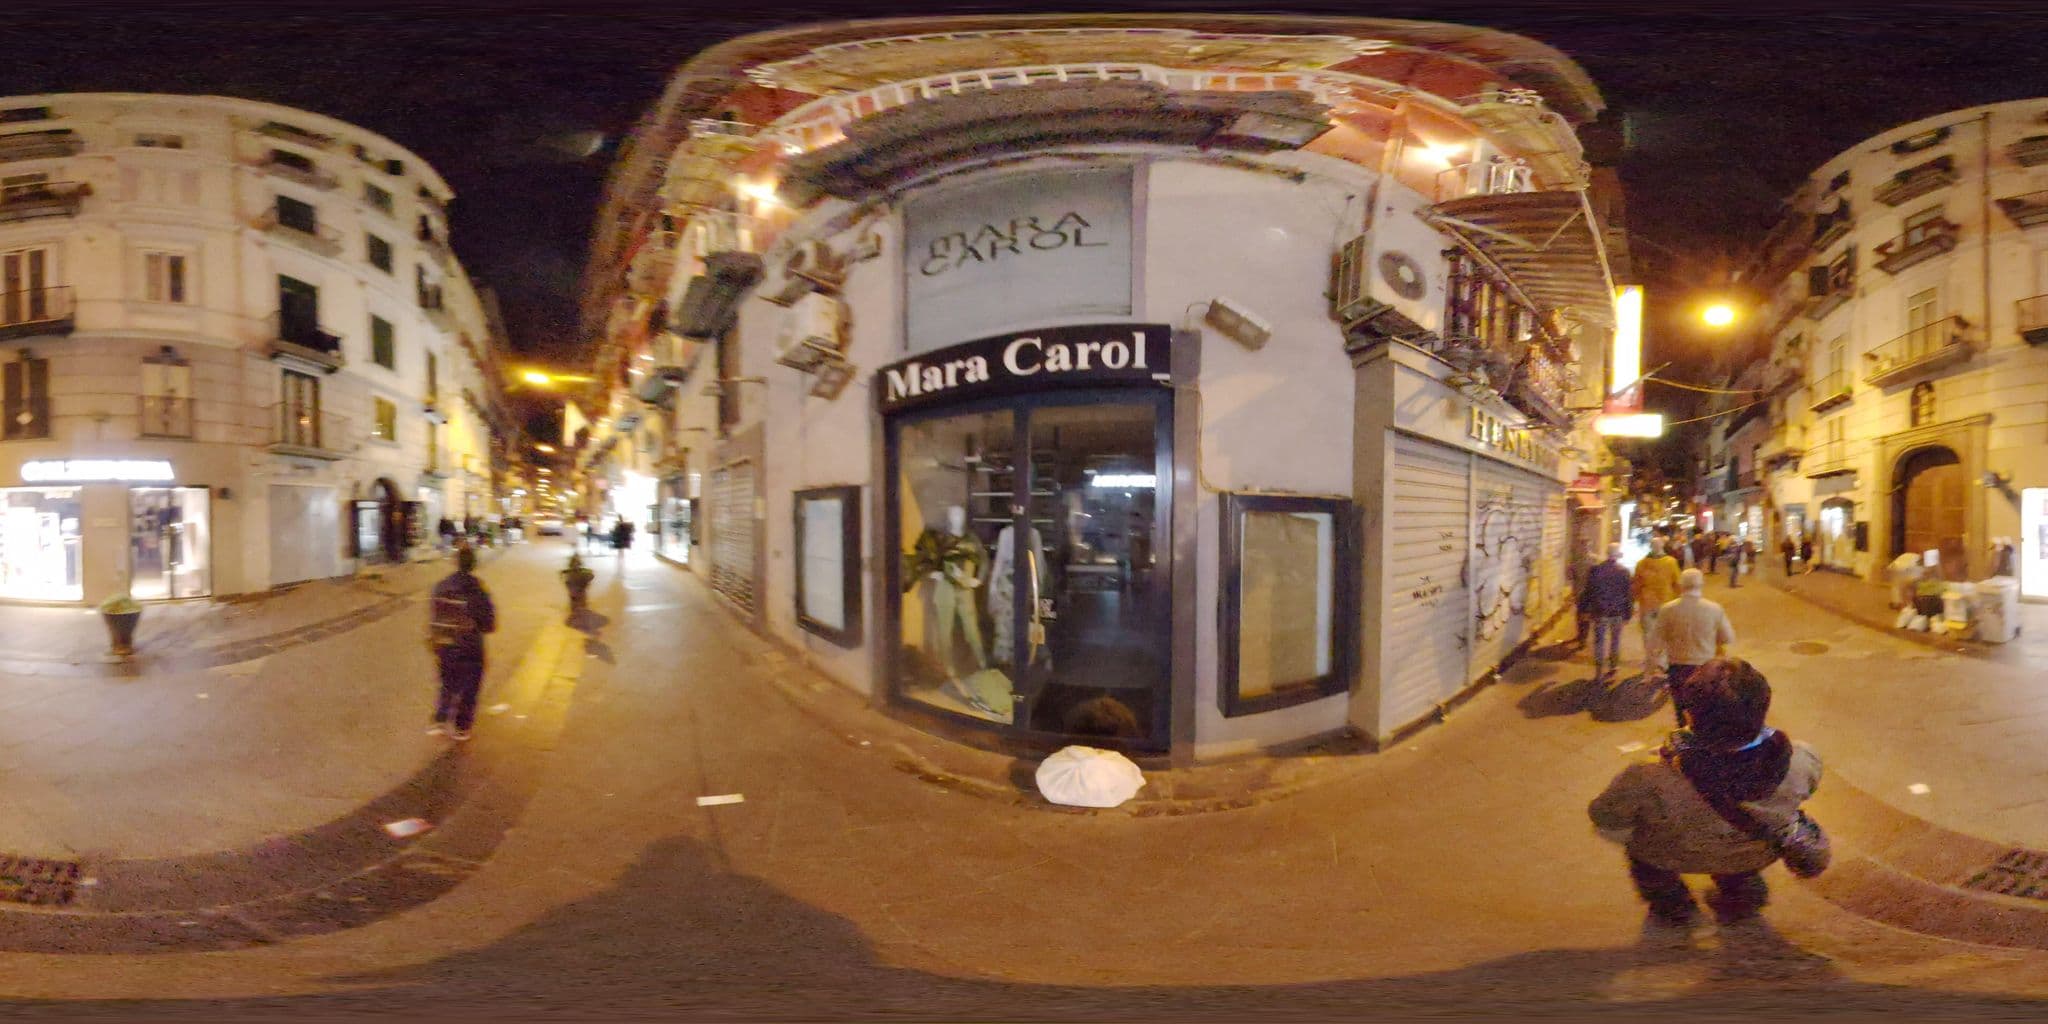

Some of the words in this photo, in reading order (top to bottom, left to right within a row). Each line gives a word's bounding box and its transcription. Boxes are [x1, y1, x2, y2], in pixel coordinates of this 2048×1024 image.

[920, 228, 1110, 276] CAROL
[930, 211, 1090, 258] MARA
[887, 355, 990, 401] Mara
[1003, 331, 1148, 376] Carol
